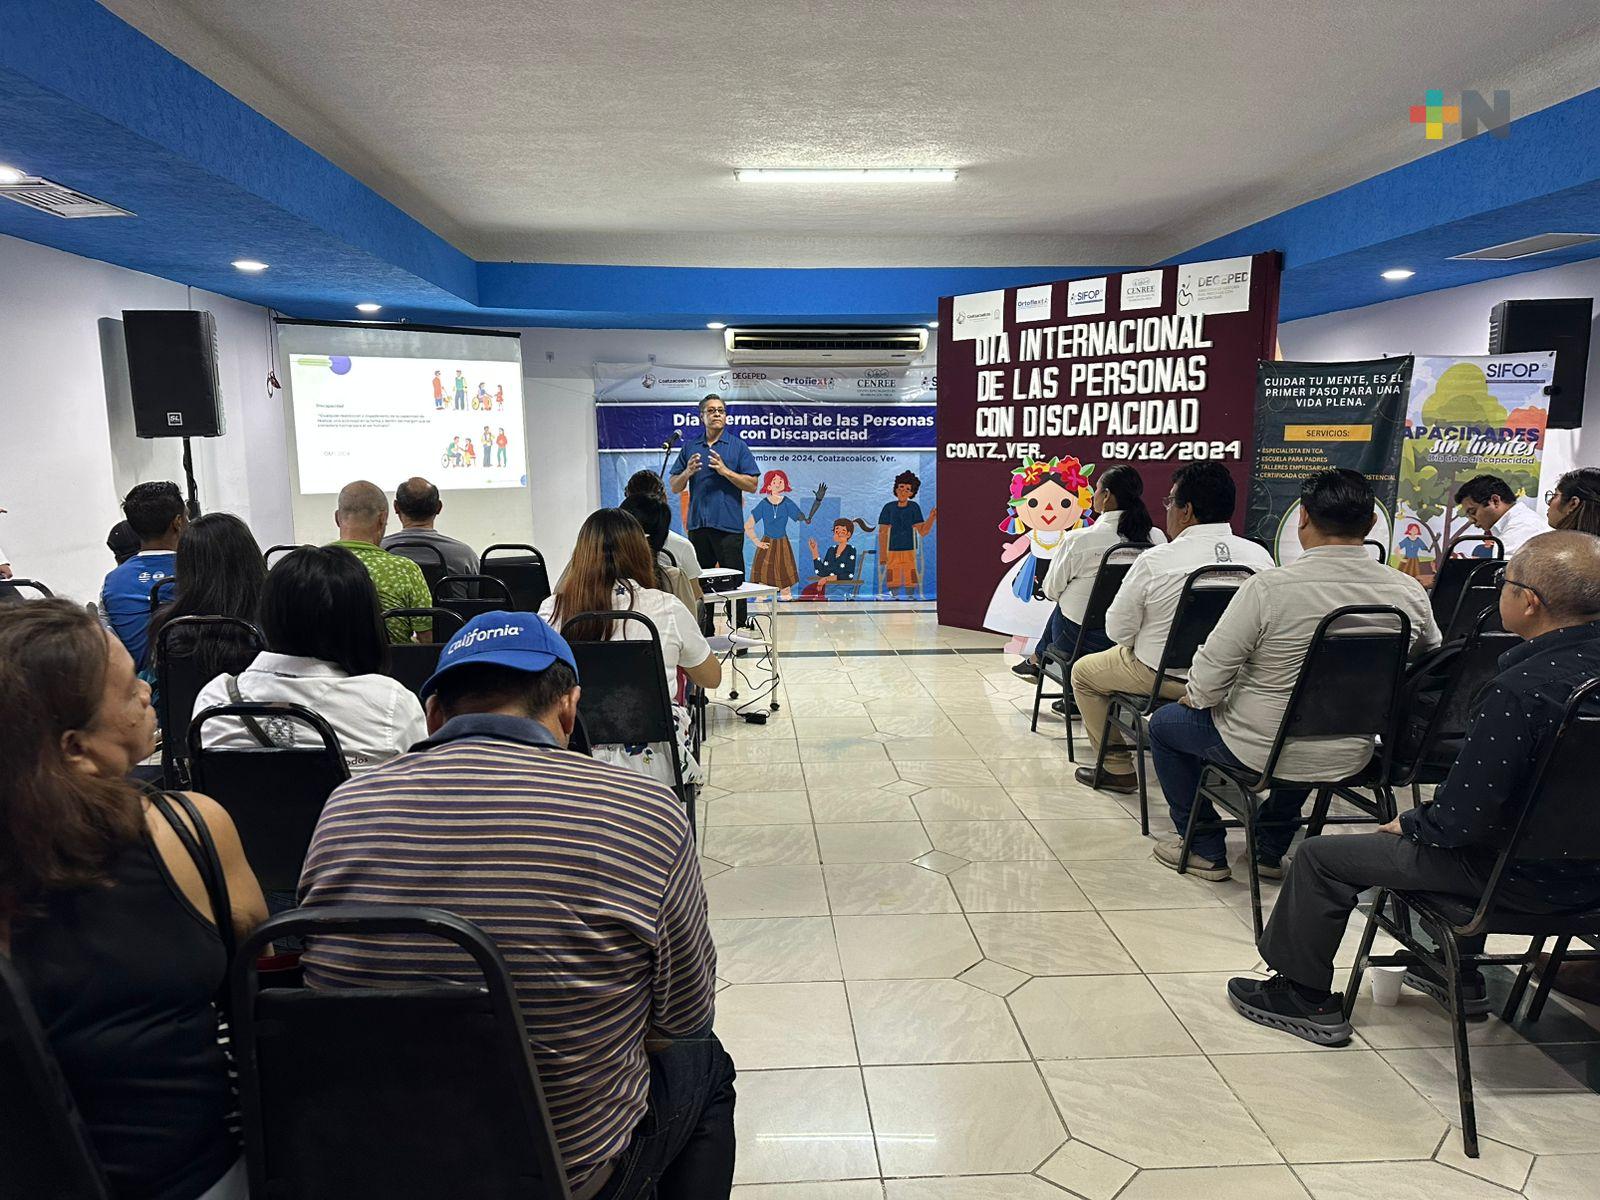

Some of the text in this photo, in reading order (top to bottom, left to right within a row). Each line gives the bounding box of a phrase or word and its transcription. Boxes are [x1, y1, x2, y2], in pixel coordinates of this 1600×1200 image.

[1077, 289, 1100, 301] SIFOP
[1019, 313, 1213, 362] INTERNACIONAL
[732, 372, 767, 380] DEGEPED
[1486, 363, 1540, 378] SIFOP
[857, 379, 896, 388] CENREE
[977, 355, 1208, 402] DE LAS PERSONAS
[1264, 374, 1404, 386] CUIDAR TU MENTE, ES EL
[1265, 385, 1401, 397] PRIMER PASO PARA UNA
[1296, 397, 1366, 407] VIDA PLENA.
[673, 413, 934, 426] Día ernacional de las Personas
[976, 398, 1199, 437] CON DISCAPACIDAD
[740, 428, 868, 442] con Discapacidad
[1306, 429, 1350, 437] SERVICIOS:
[1404, 426, 1540, 440] APACIDADES
[1101, 440, 1241, 460] 09/12/2024
[1429, 435, 1461, 454] sin
